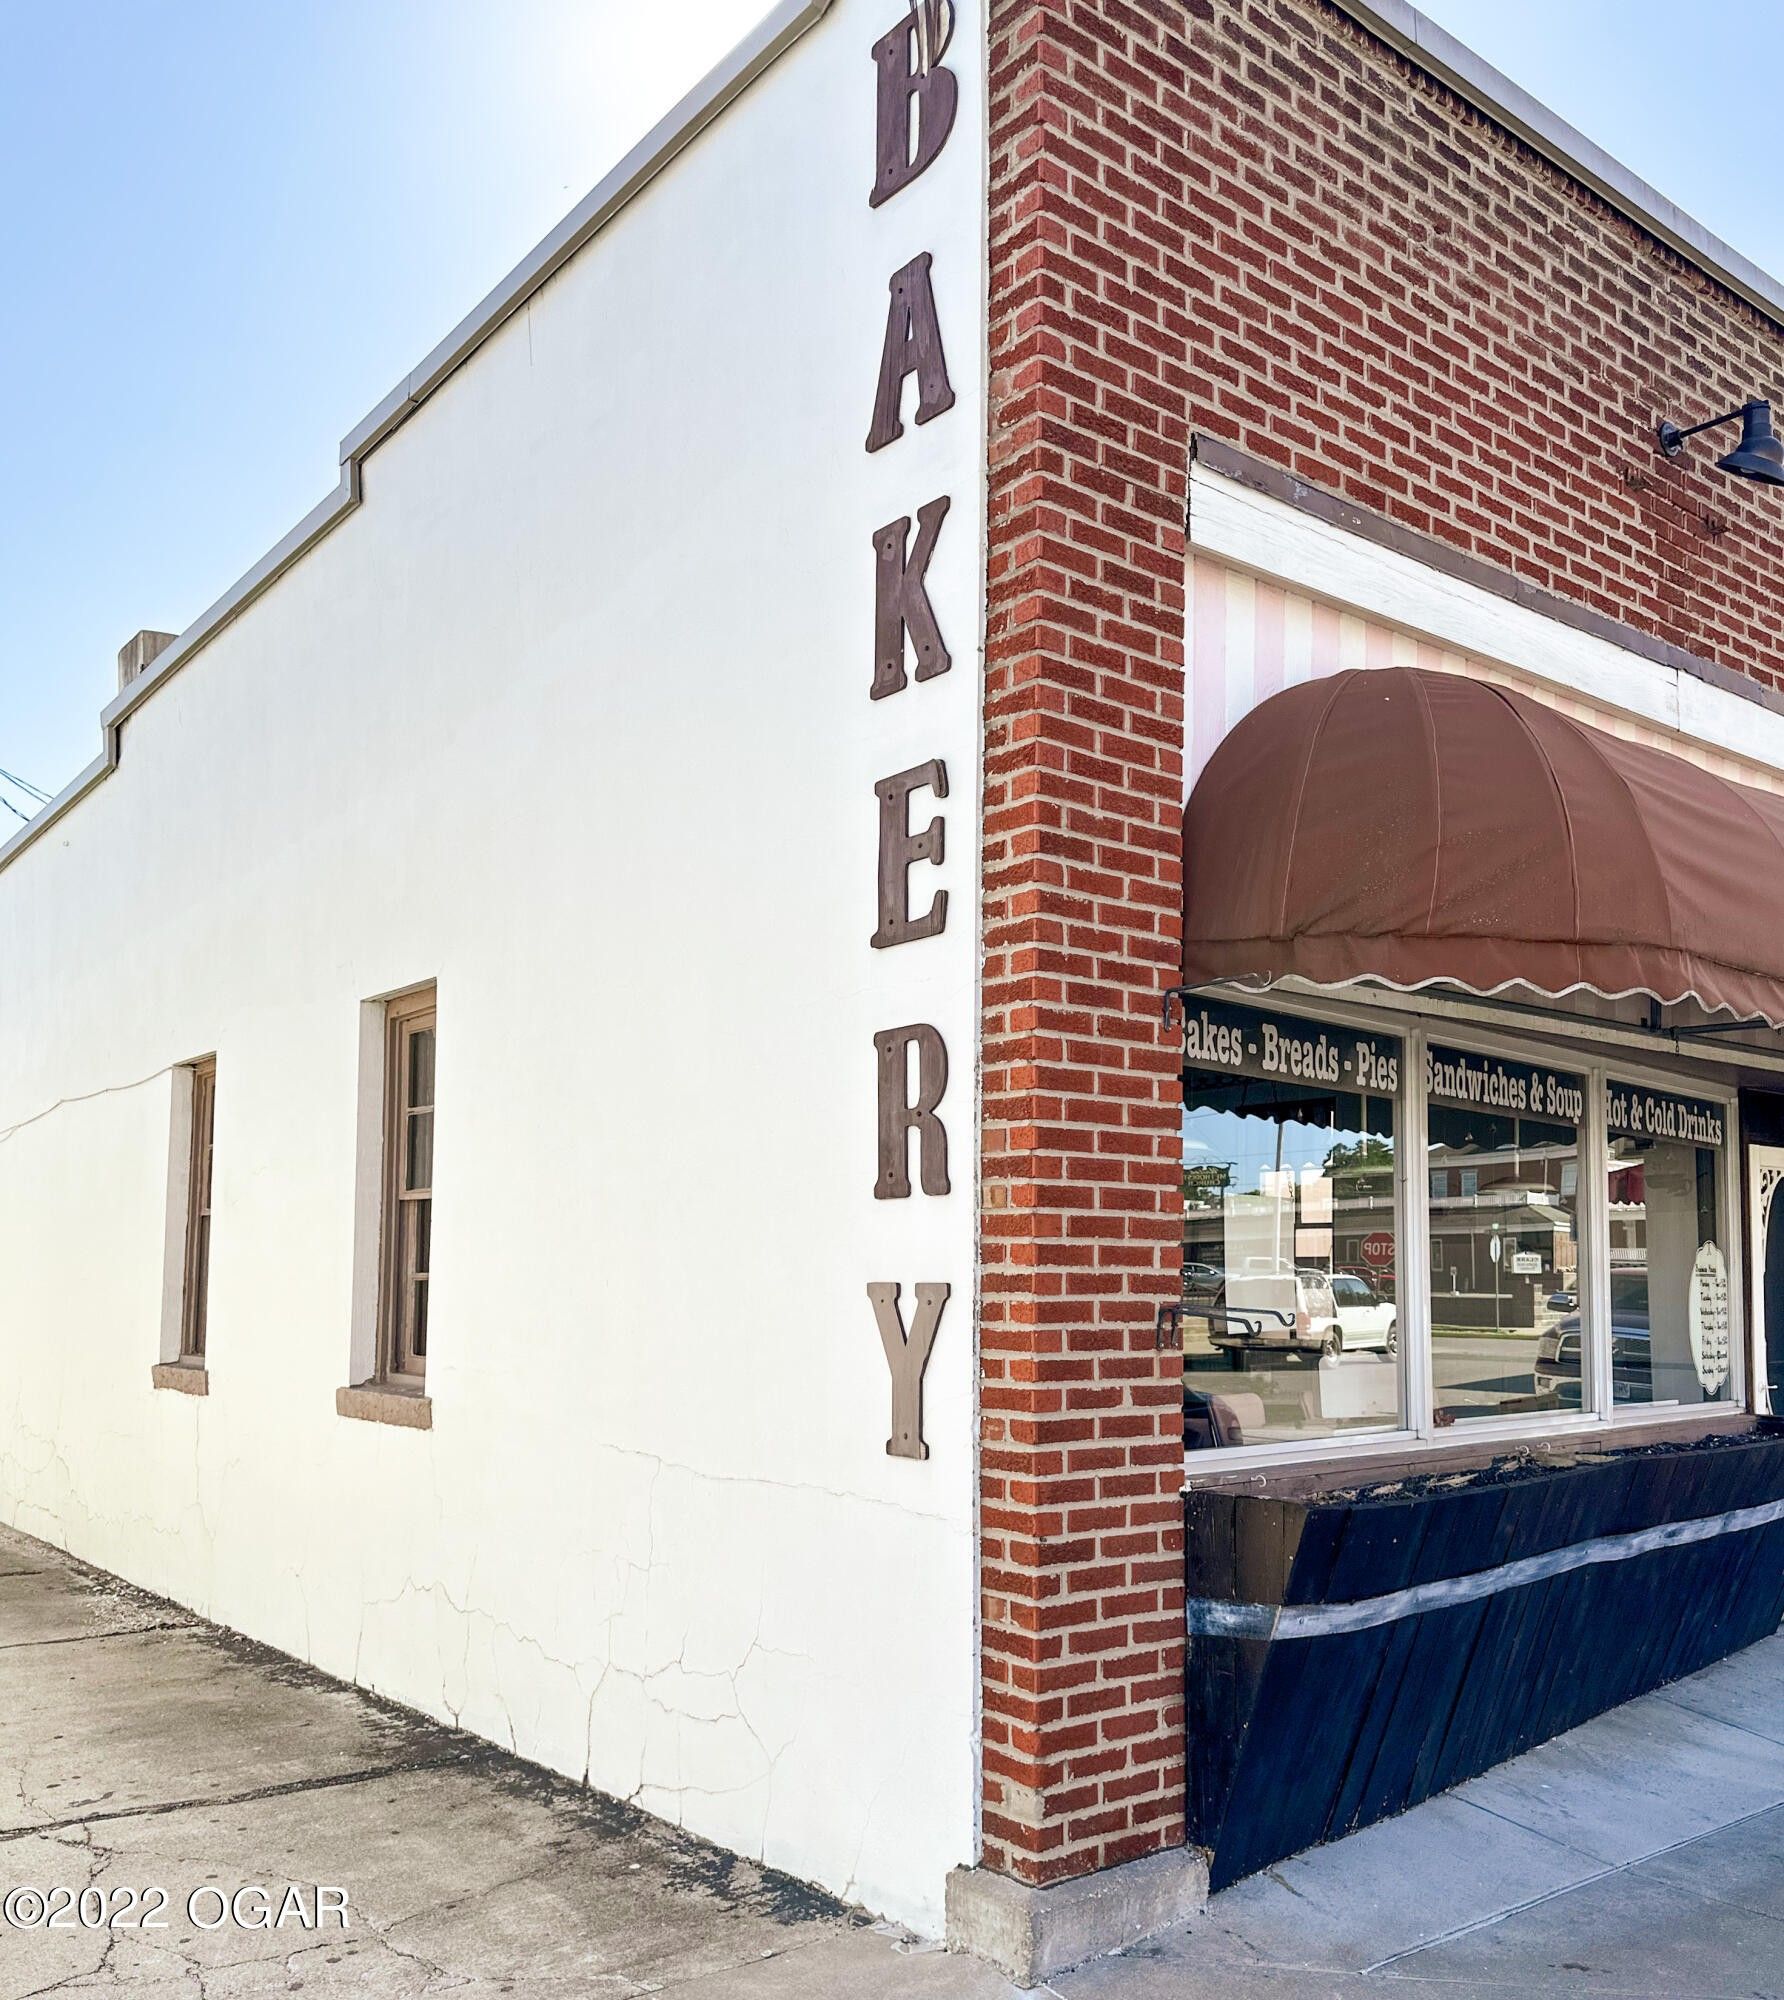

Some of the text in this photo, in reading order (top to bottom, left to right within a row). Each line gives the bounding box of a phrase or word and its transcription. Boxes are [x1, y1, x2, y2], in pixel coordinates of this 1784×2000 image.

[865, 0, 958, 1460] BAKERY
[1262, 1023, 1339, 1082] Breads
[1356, 1041, 1398, 1092] Pies
[1424, 1050, 1583, 1126] Sandwiches & Soup
[1631, 1093, 1643, 1132] &
[1645, 1096, 1674, 1137] Cold
[1678, 1104, 1722, 1146] Drinks
